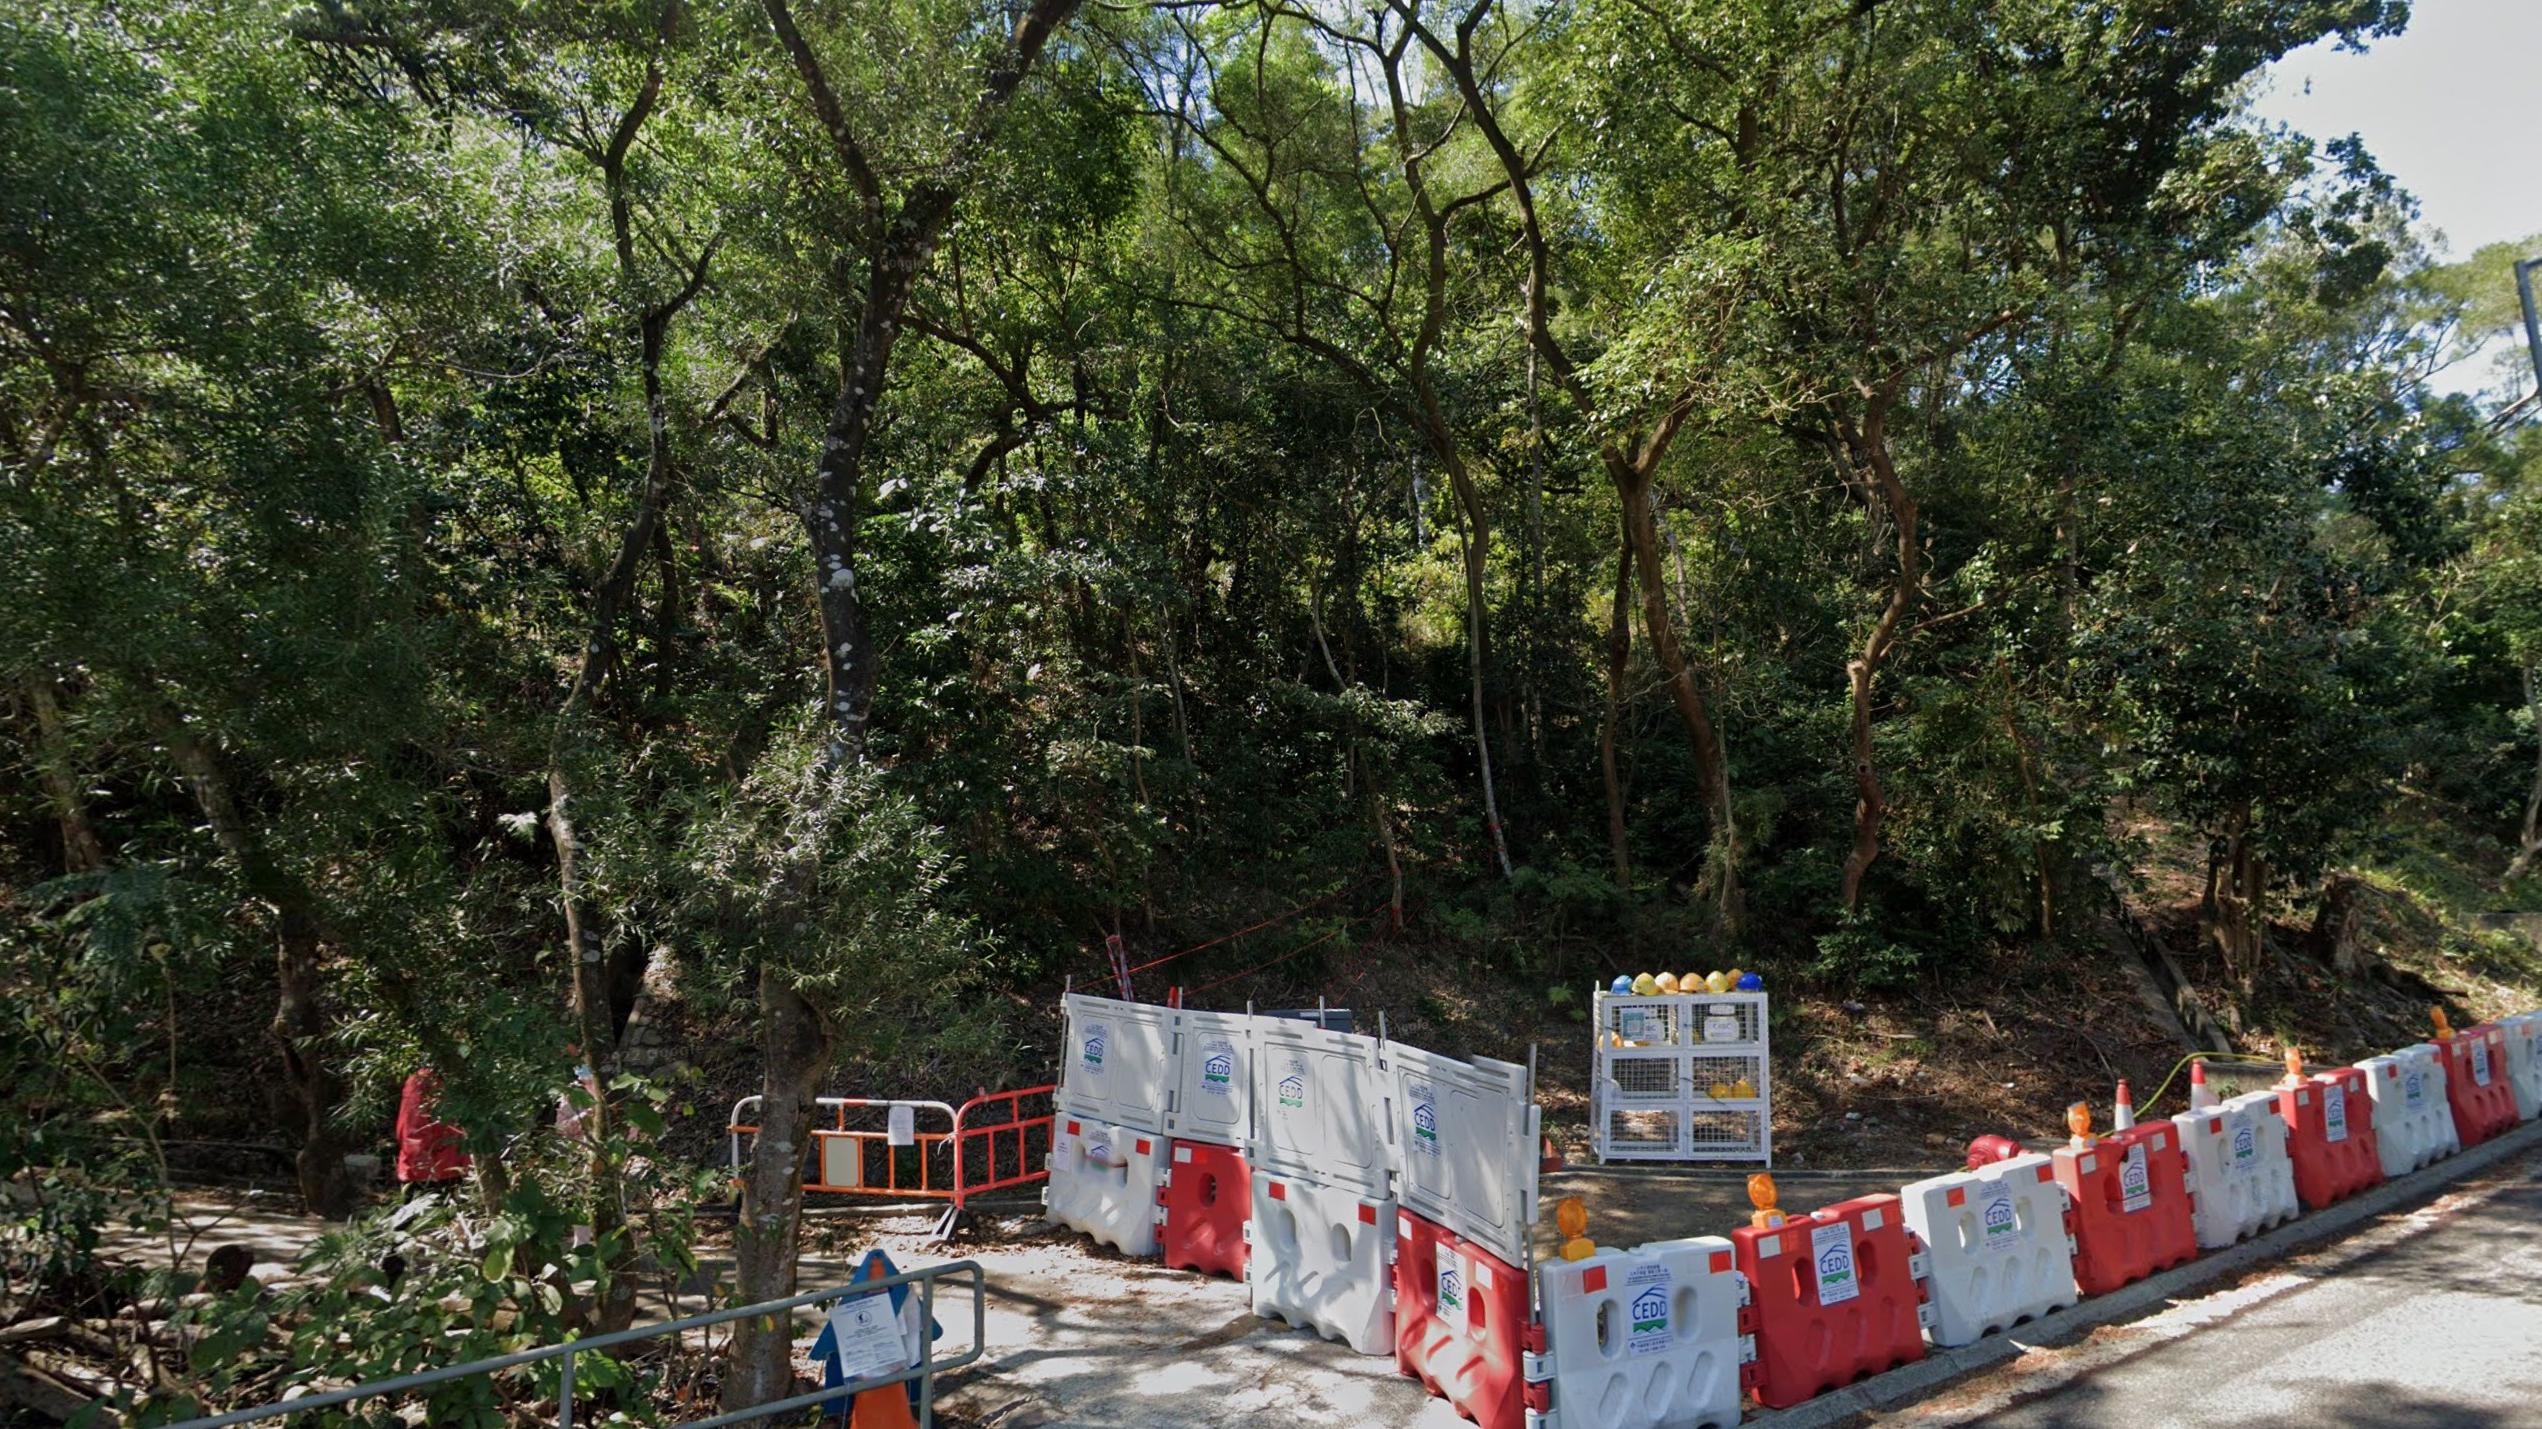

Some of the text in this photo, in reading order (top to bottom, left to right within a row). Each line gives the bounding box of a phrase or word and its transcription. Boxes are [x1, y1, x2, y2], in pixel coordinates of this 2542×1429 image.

[1205, 1063, 1230, 1075] CEDD
[1279, 1084, 1303, 1099] CEDD
[1414, 1112, 1435, 1131] CEDD
[1985, 1208, 2011, 1226] CEDD
[1820, 1255, 1850, 1274] CEDD
[1632, 1301, 1667, 1320] CEDD
